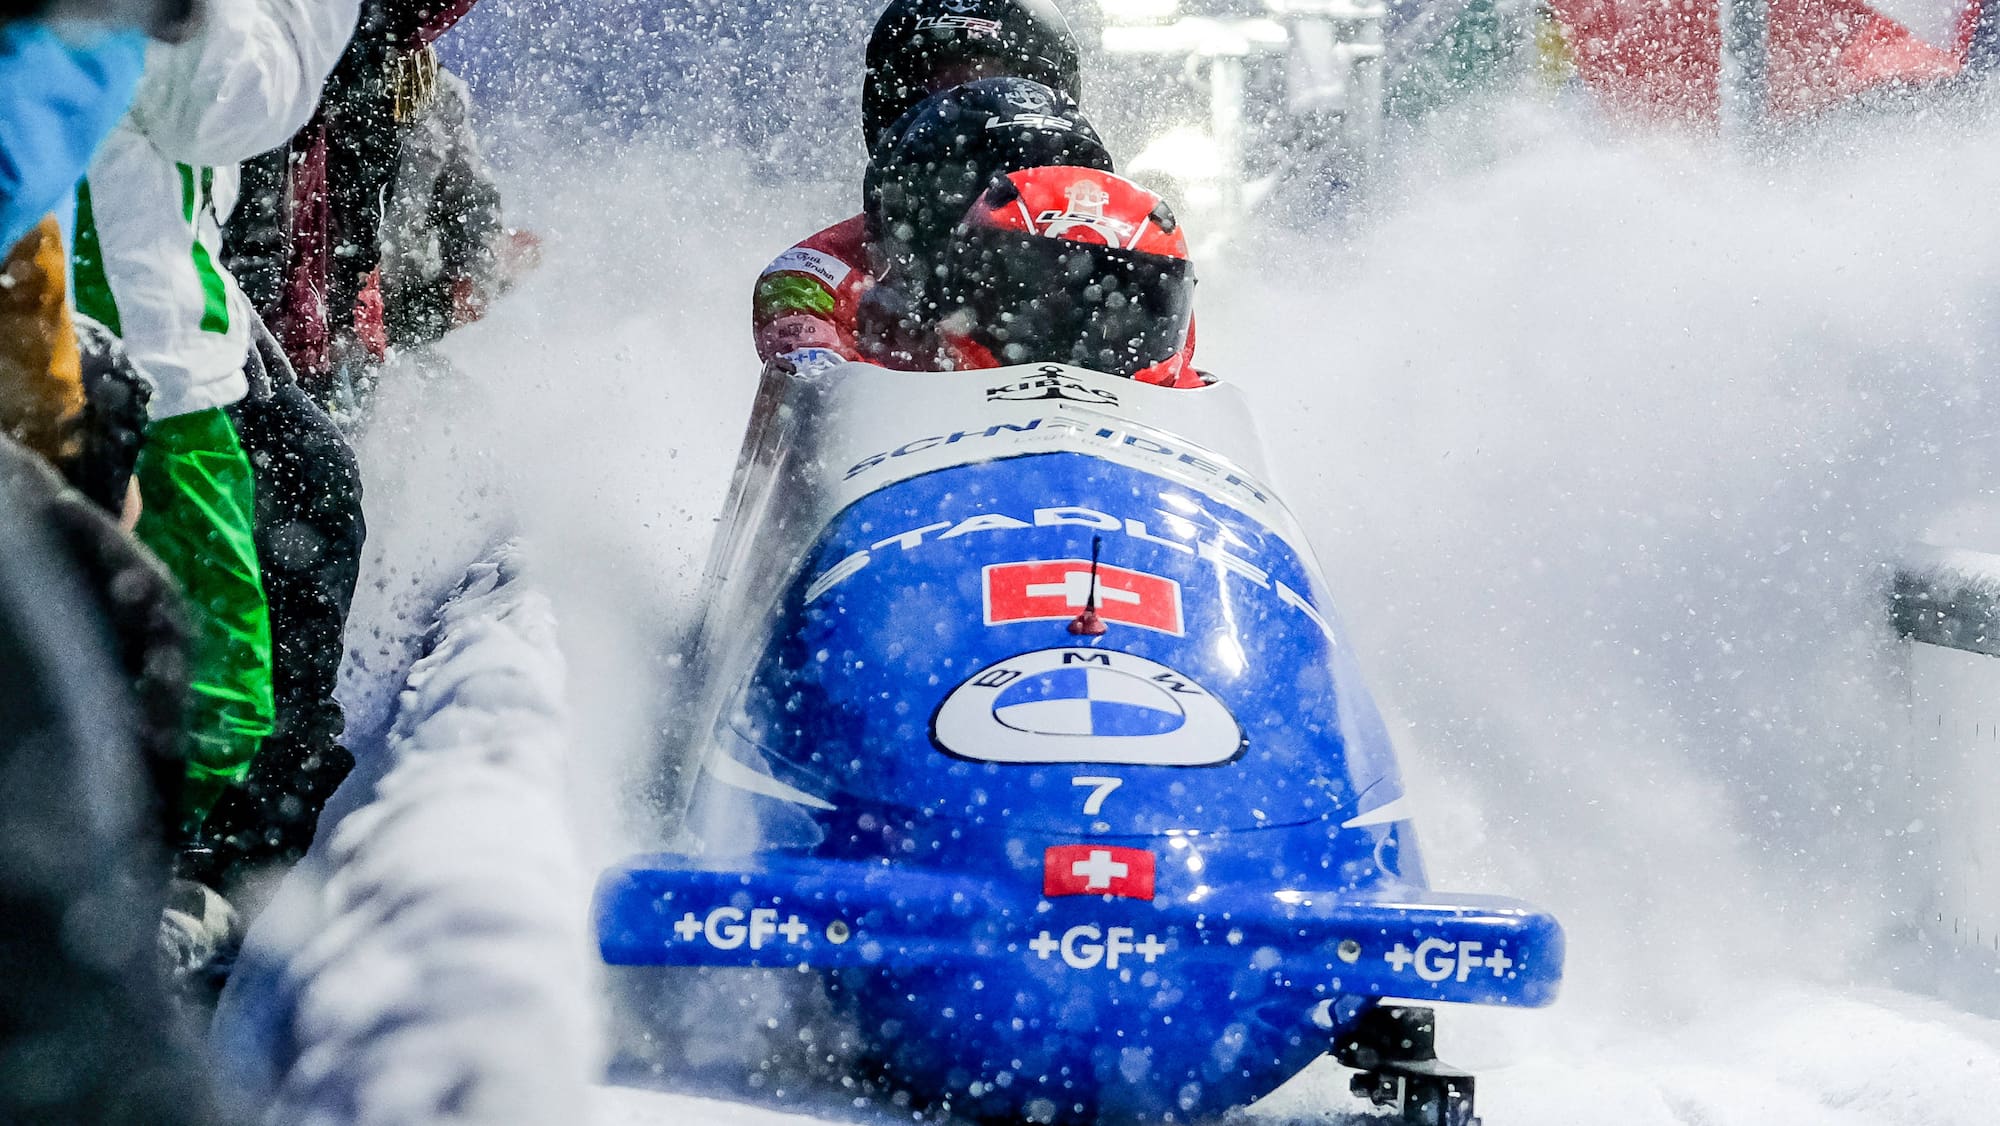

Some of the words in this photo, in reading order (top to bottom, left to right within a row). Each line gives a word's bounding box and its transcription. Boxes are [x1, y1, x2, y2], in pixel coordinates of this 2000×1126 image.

[985, 113, 1074, 131] LS2
[986, 378, 1119, 401] KIBAG
[843, 418, 1269, 503] SCHNEIDER
[803, 507, 1337, 645] STADLER
[972, 652, 1201, 695] BMW
[1072, 776, 1123, 815] 7
